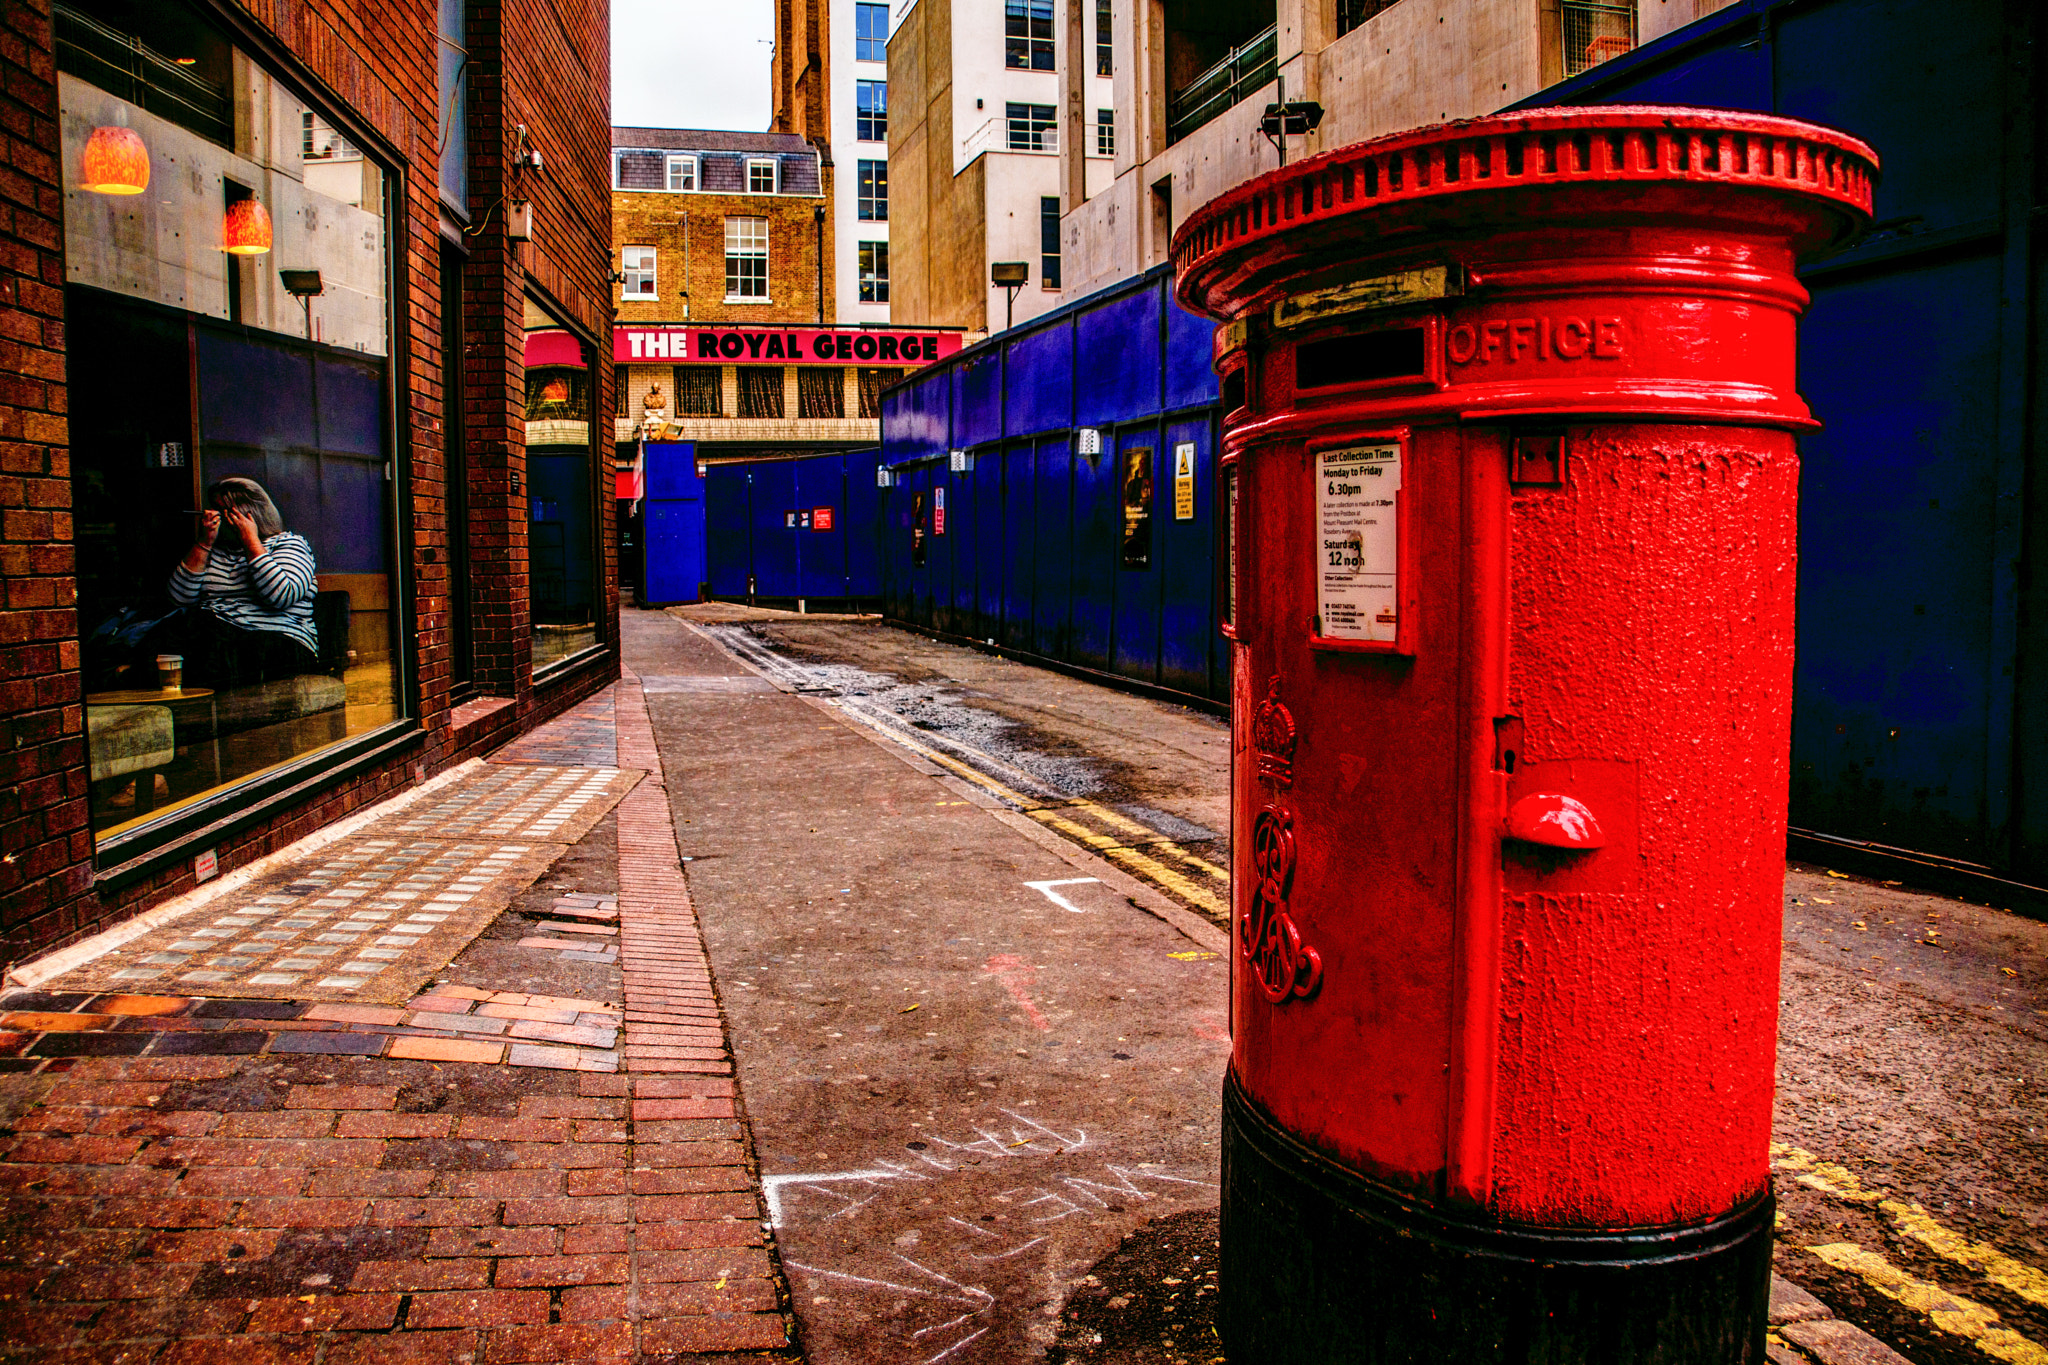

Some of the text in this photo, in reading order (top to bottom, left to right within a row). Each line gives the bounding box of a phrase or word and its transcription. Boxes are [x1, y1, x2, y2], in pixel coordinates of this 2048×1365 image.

[628, 332, 938, 361] THE ROYAL GEORGE
[1448, 316, 1623, 364] OFFICE
[1323, 449, 1394, 463] Last Collection Time
[1323, 466, 1383, 479] Monday to Friday
[1328, 481, 1362, 497] 6.30pm
[1324, 540, 1360, 551] Saturday
[1328, 551, 1342, 566] 12
